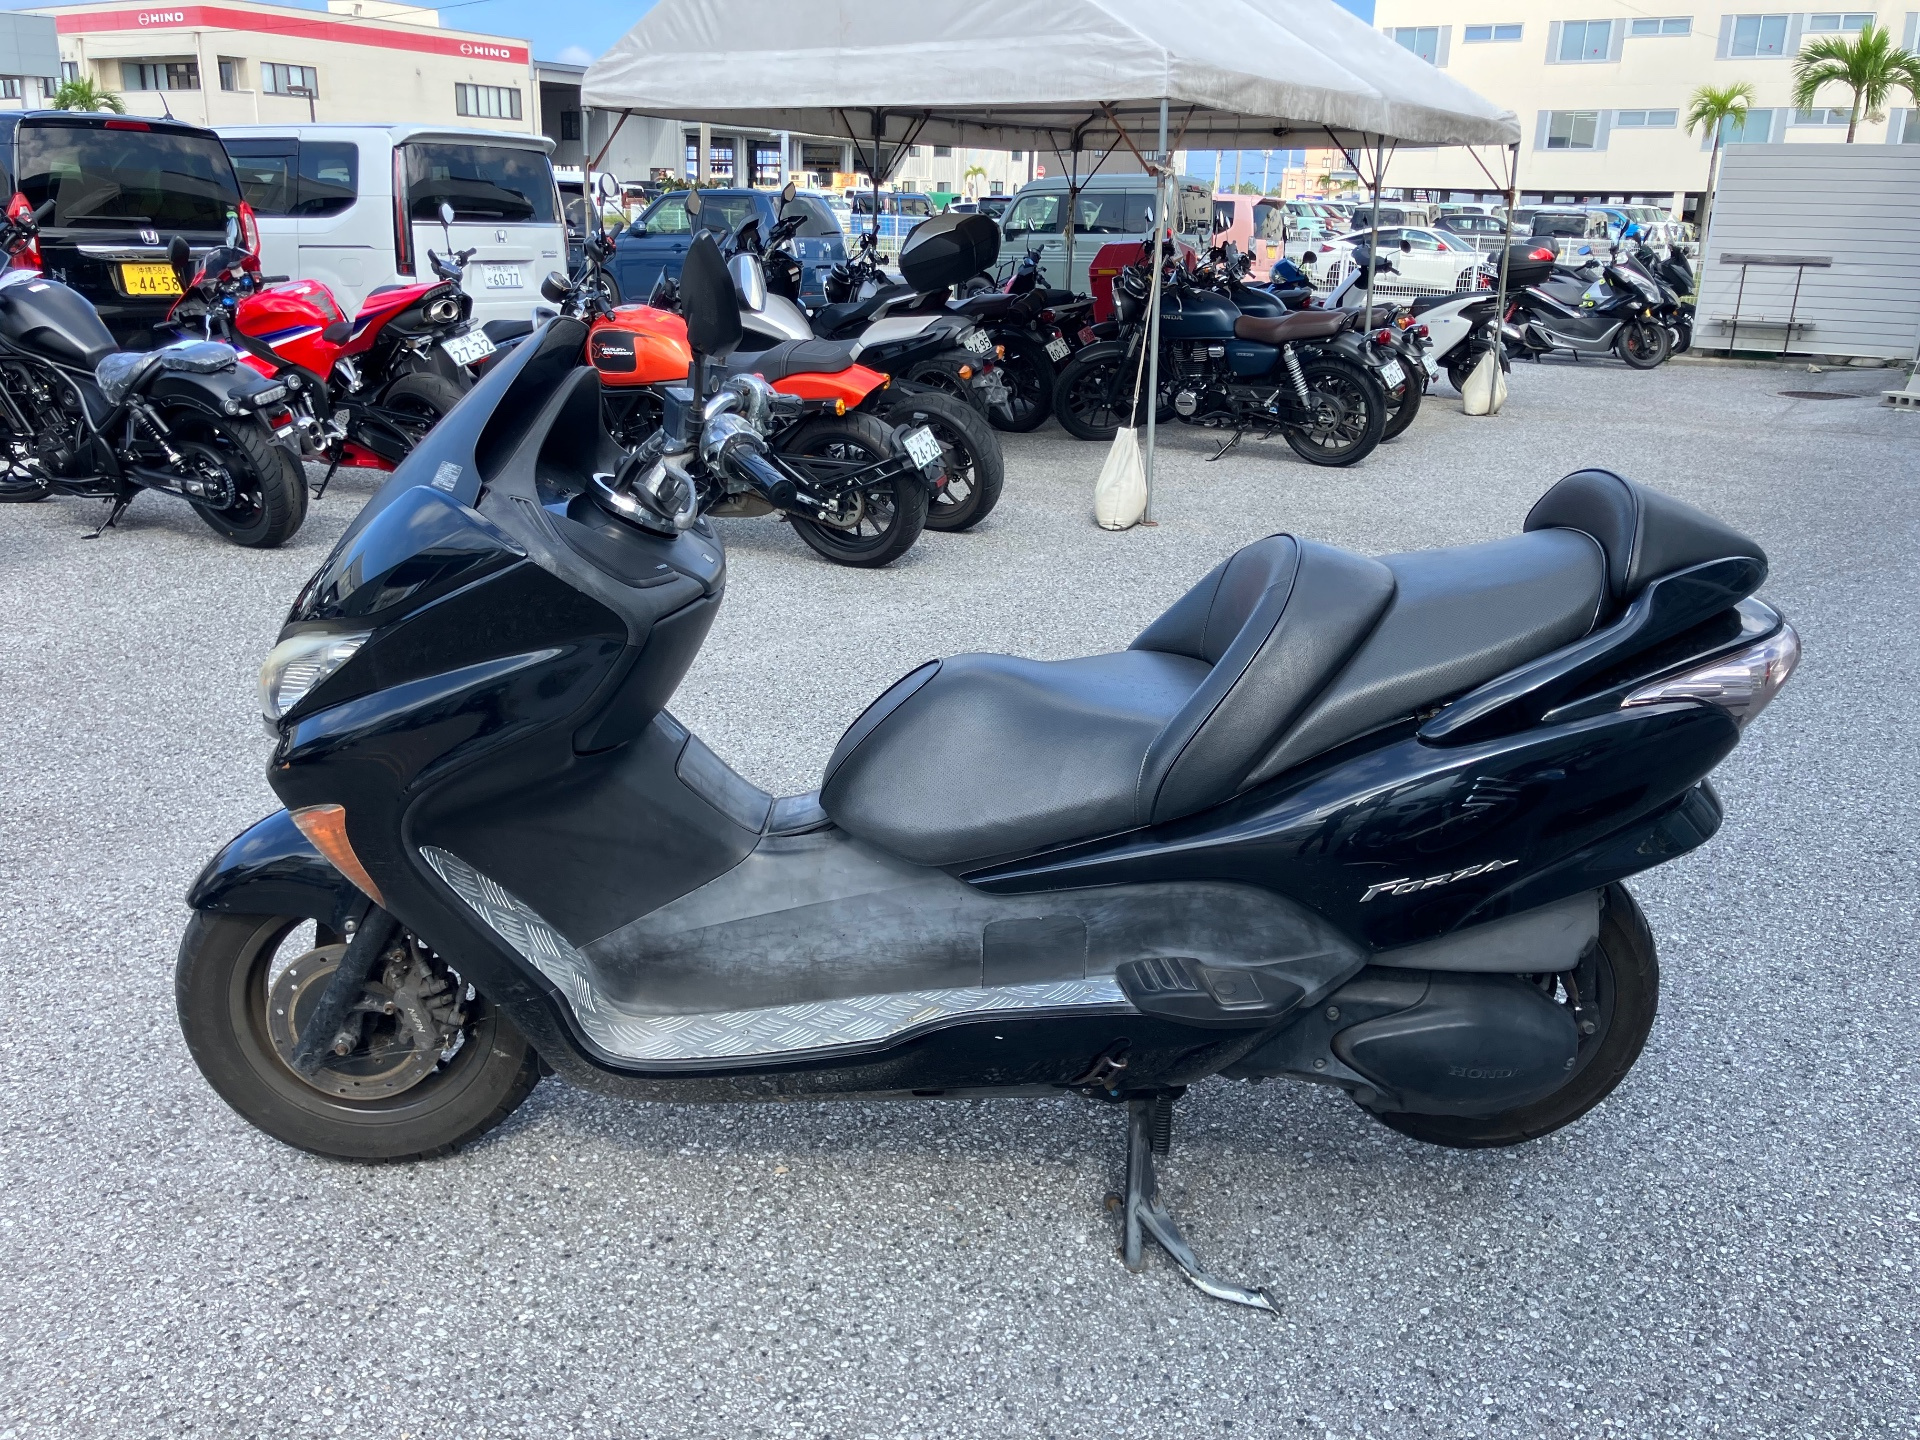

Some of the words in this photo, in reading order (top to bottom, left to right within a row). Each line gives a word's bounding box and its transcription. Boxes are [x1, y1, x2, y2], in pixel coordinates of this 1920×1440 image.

[150, 12, 184, 23] HINO
[474, 46, 510, 58] HINO
[140, 277, 179, 291] 44-58
[494, 274, 519, 285] 60-77
[453, 339, 495, 364] 27-32
[1386, 367, 1404, 387] 30-17
[912, 439, 940, 467] 24-28
[1359, 860, 1519, 903] FORZA
[1448, 1065, 1524, 1079] HONDA
